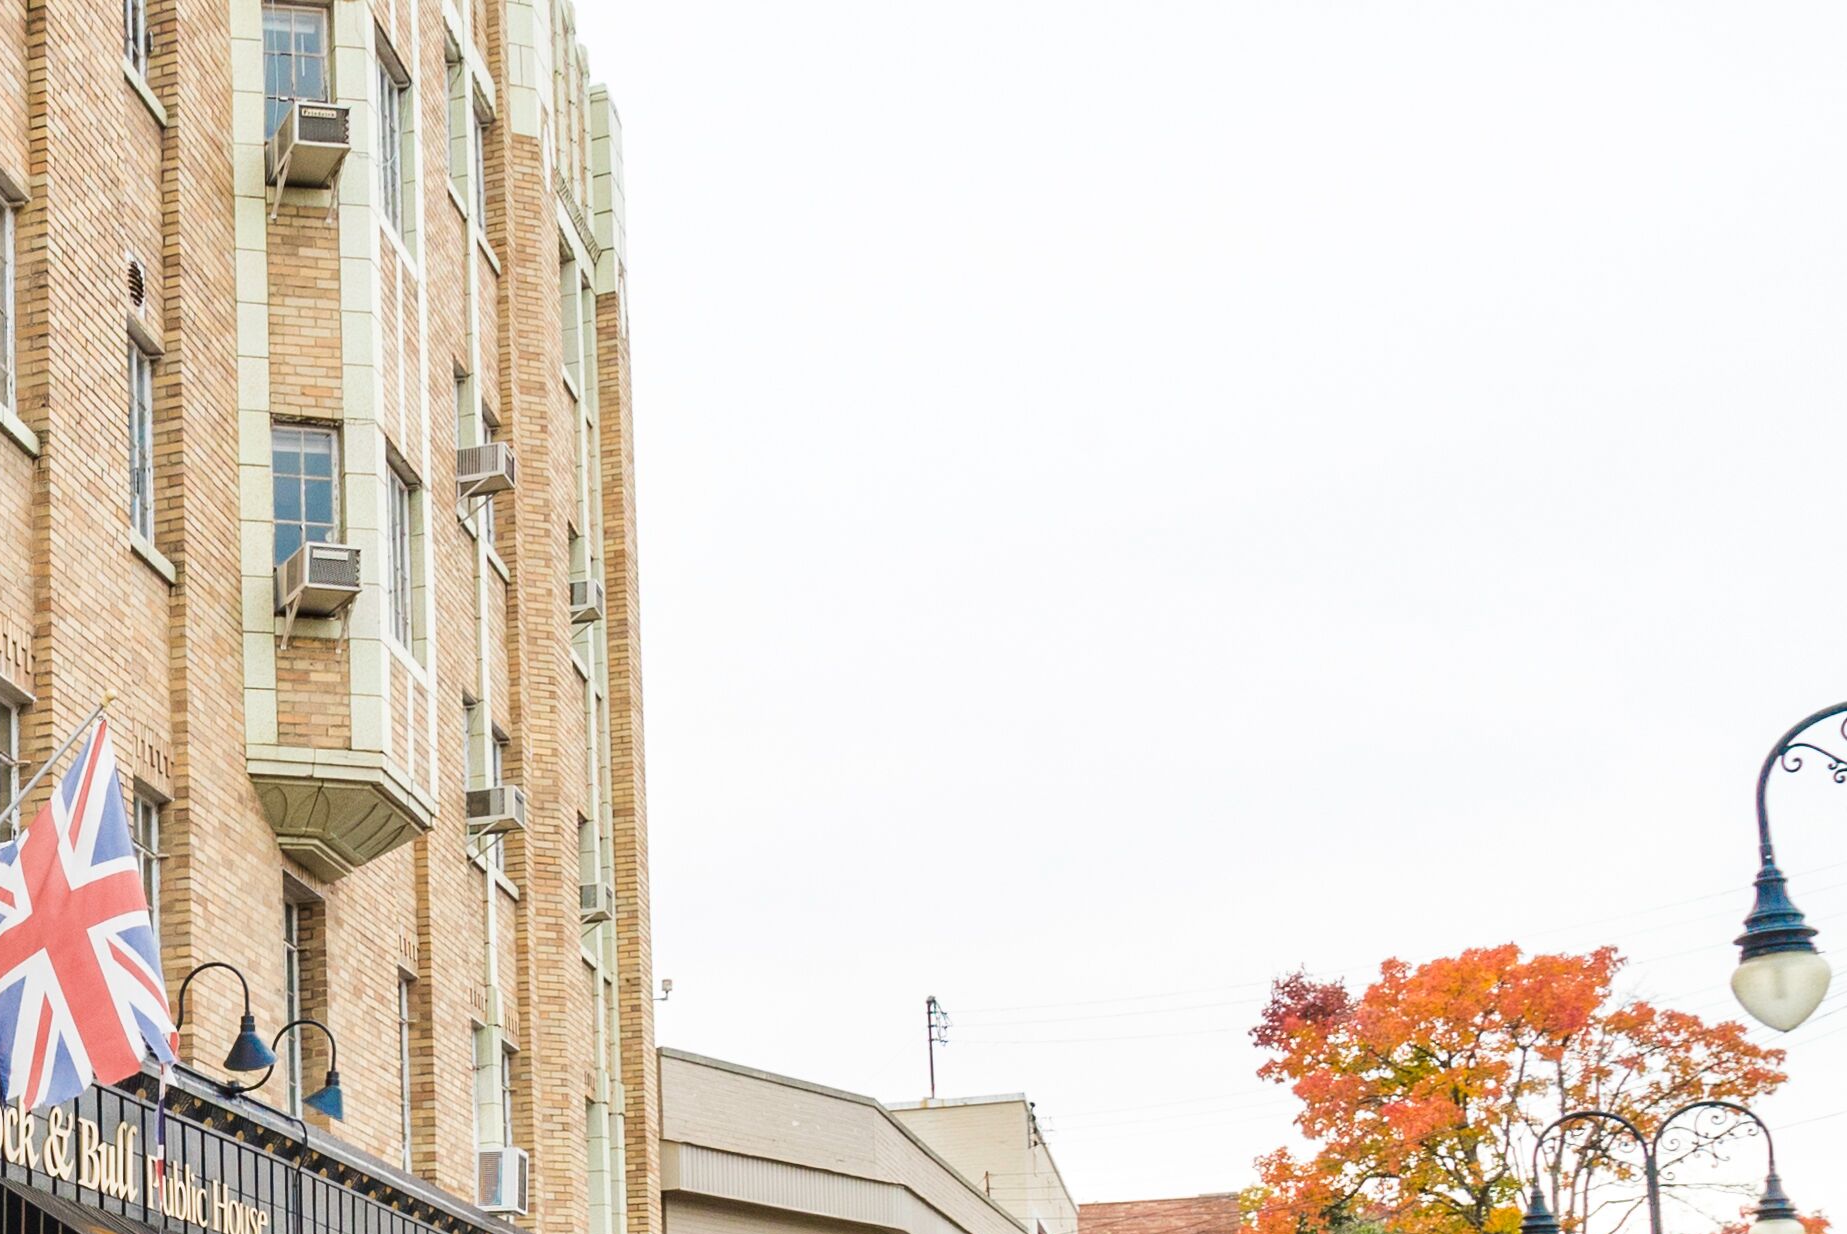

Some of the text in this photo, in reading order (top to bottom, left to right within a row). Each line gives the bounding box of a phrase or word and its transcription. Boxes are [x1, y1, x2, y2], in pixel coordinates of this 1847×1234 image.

[43, 1106, 75, 1181] &
[78, 1121, 138, 1204] Bull
[146, 1152, 208, 1228] Public
